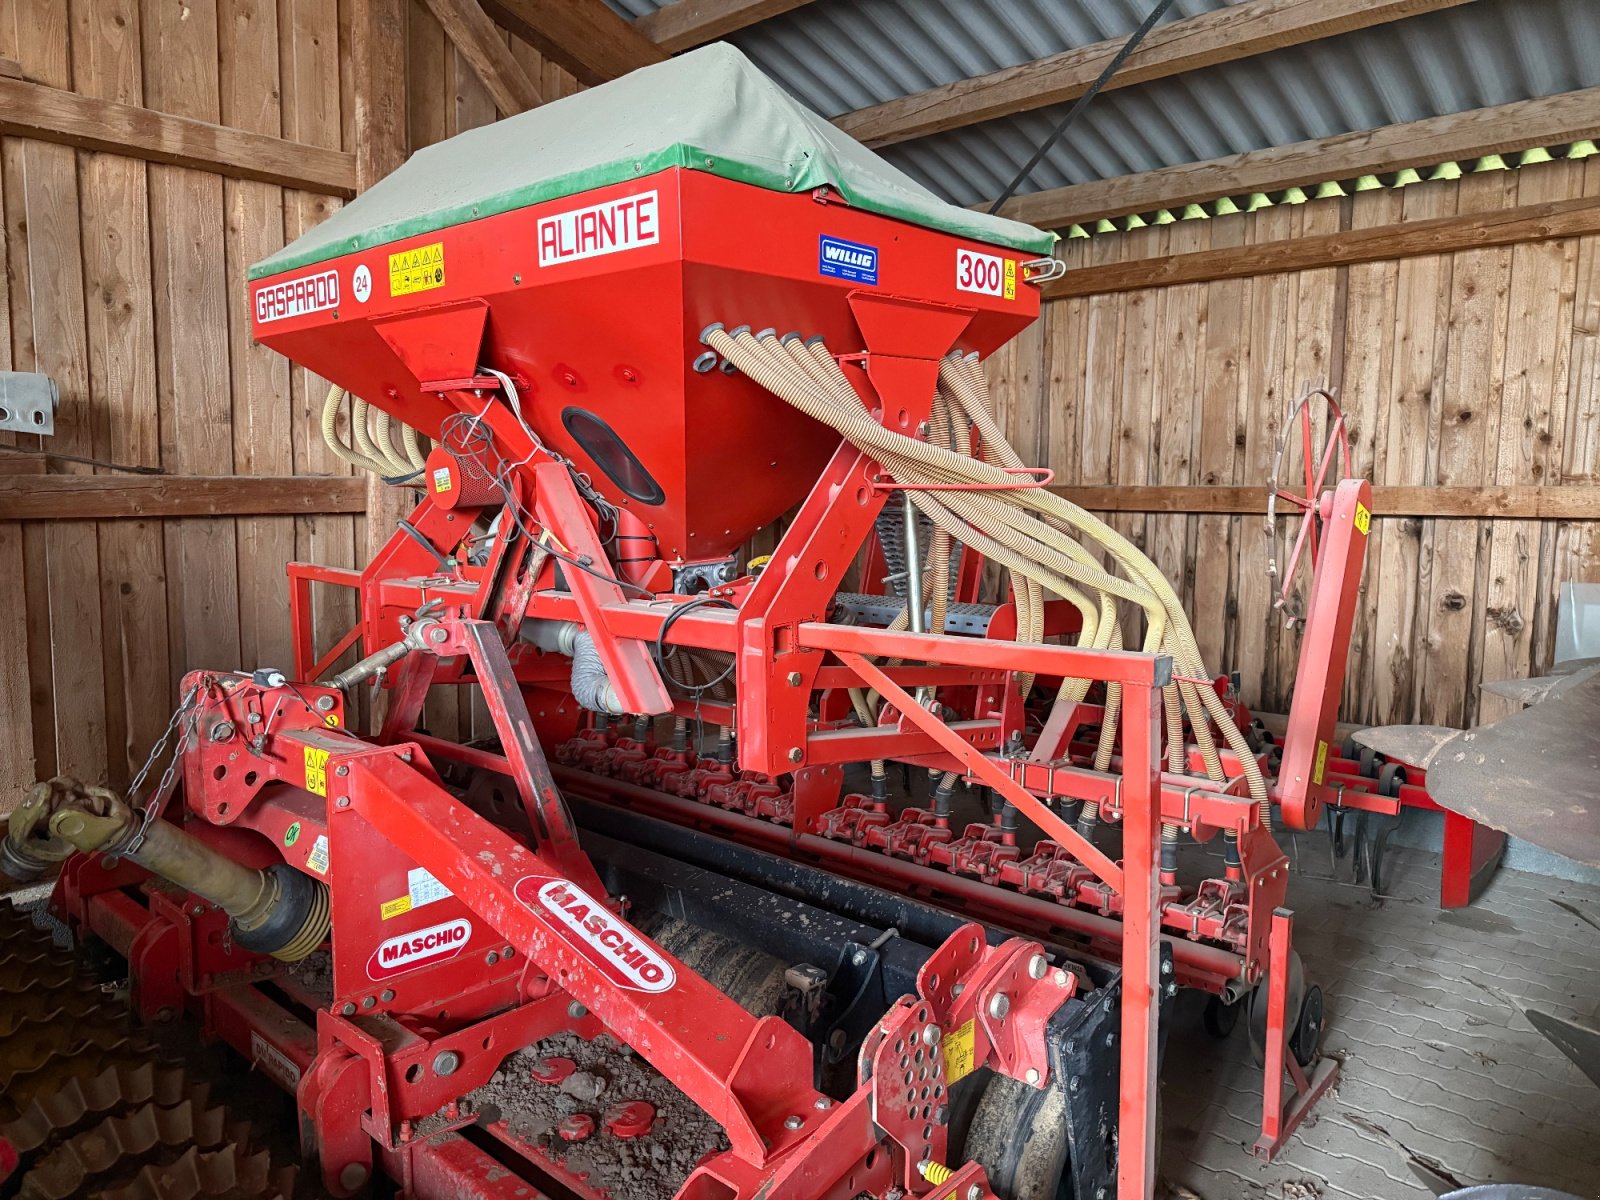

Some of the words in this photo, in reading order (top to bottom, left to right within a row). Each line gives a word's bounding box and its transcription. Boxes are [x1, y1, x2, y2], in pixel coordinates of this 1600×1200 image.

[541, 196, 655, 261] ALIANTE
[825, 245, 873, 267] WILLIG
[959, 254, 1000, 291] 300
[257, 273, 338, 320] GASPARDO
[355, 275, 368, 293] 24
[286, 825, 300, 843] OK
[382, 926, 466, 962] MASCHIO
[544, 884, 665, 984] MASCHIO
